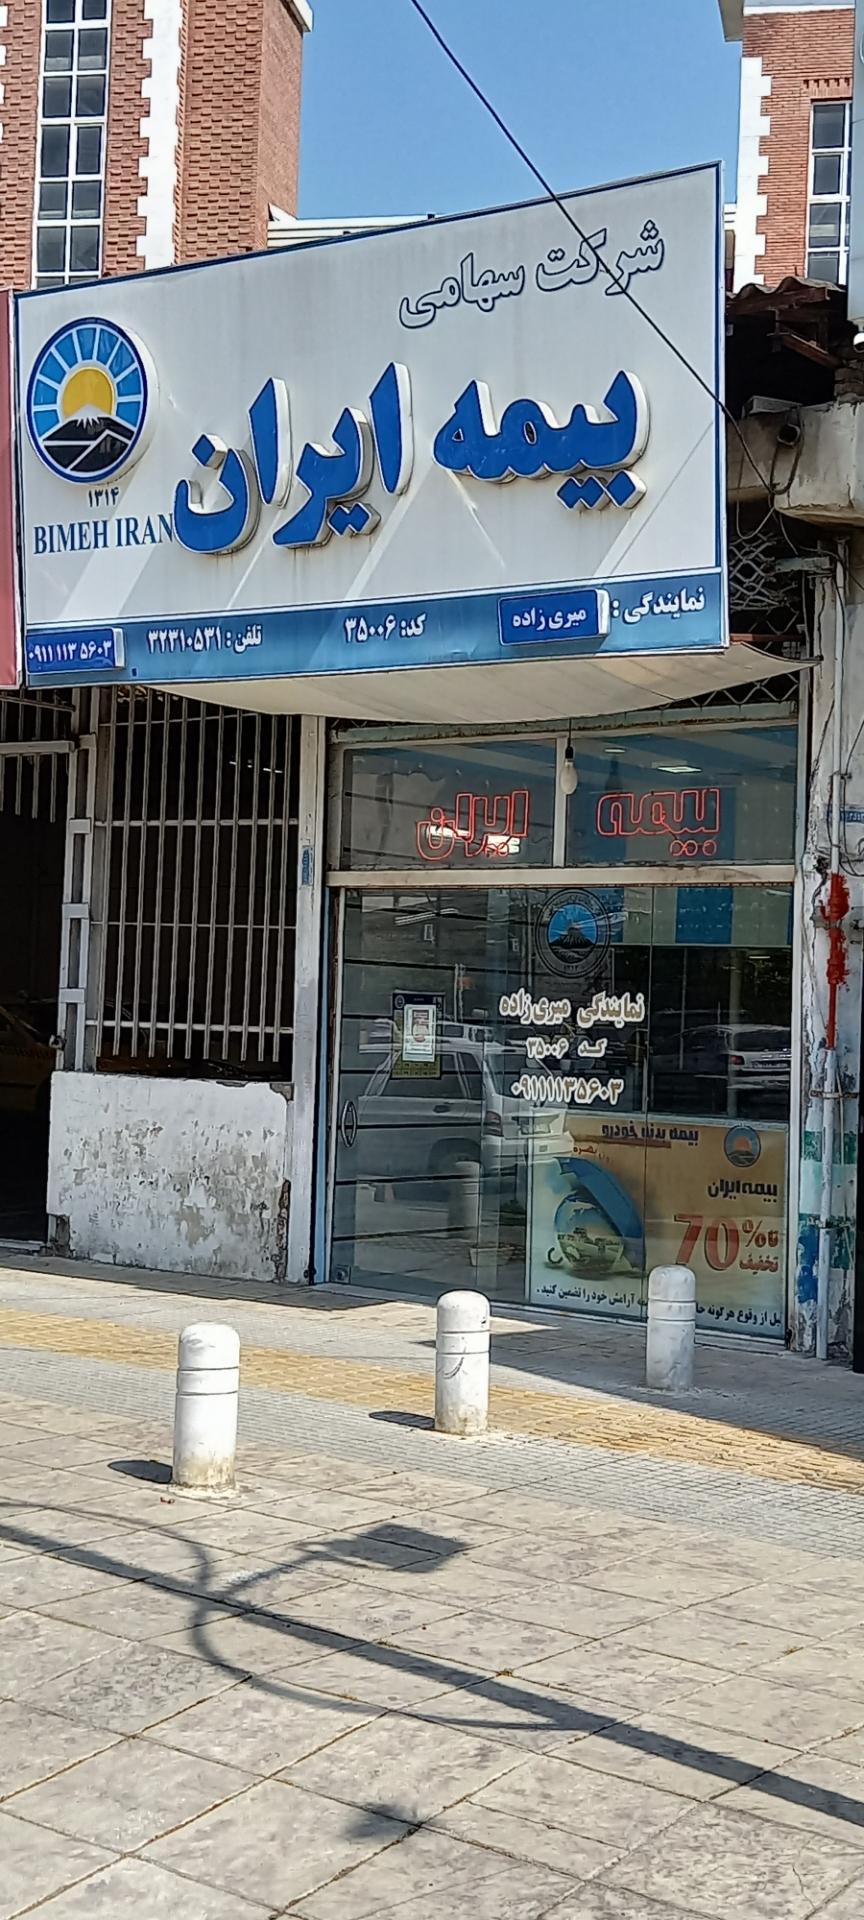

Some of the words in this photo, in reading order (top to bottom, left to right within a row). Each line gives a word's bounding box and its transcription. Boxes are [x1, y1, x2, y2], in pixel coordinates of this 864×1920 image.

[537, 219, 665, 297] شرکت
[399, 252, 525, 330] سهامی
[433, 369, 648, 510] بیمه
[174, 361, 414, 555] ایران
[88, 486, 119, 507] ۱۳۱۴
[33, 520, 109, 554] BIMEH
[115, 513, 173, 547] IRAN
[624, 586, 706, 624] نمایندگی
[344, 615, 396, 643] ۳۵۰۰۶
[512, 607, 546, 631] زاده
[548, 608, 586, 629] میری
[148, 625, 222, 655] ۳۲۳۱۰۵۳۱
[416, 789, 530, 861] ایران
[596, 787, 721, 857] بیمه
[532, 997, 571, 1024] میری
[577, 991, 645, 1028] نمایندگی
[526, 1037, 569, 1059] ۳۵۰۰۶
[511, 1074, 624, 1105] ۰۹۱۱۱۱۳۵۶۰۳
[602, 1120, 638, 1139] خودرو
[669, 1127, 698, 1146] بیمه
[708, 1179, 740, 1199] ایران
[742, 1182, 778, 1203] بیمه
[739, 1254, 779, 1275] تخفیف
[558, 1287, 582, 1300] تضمین
[583, 1288, 590, 1302] را
[591, 1290, 607, 1304] خود
[609, 1292, 635, 1308] آرامش
[736, 1308, 758, 1324] وقوع
[760, 1311, 768, 1325] از
